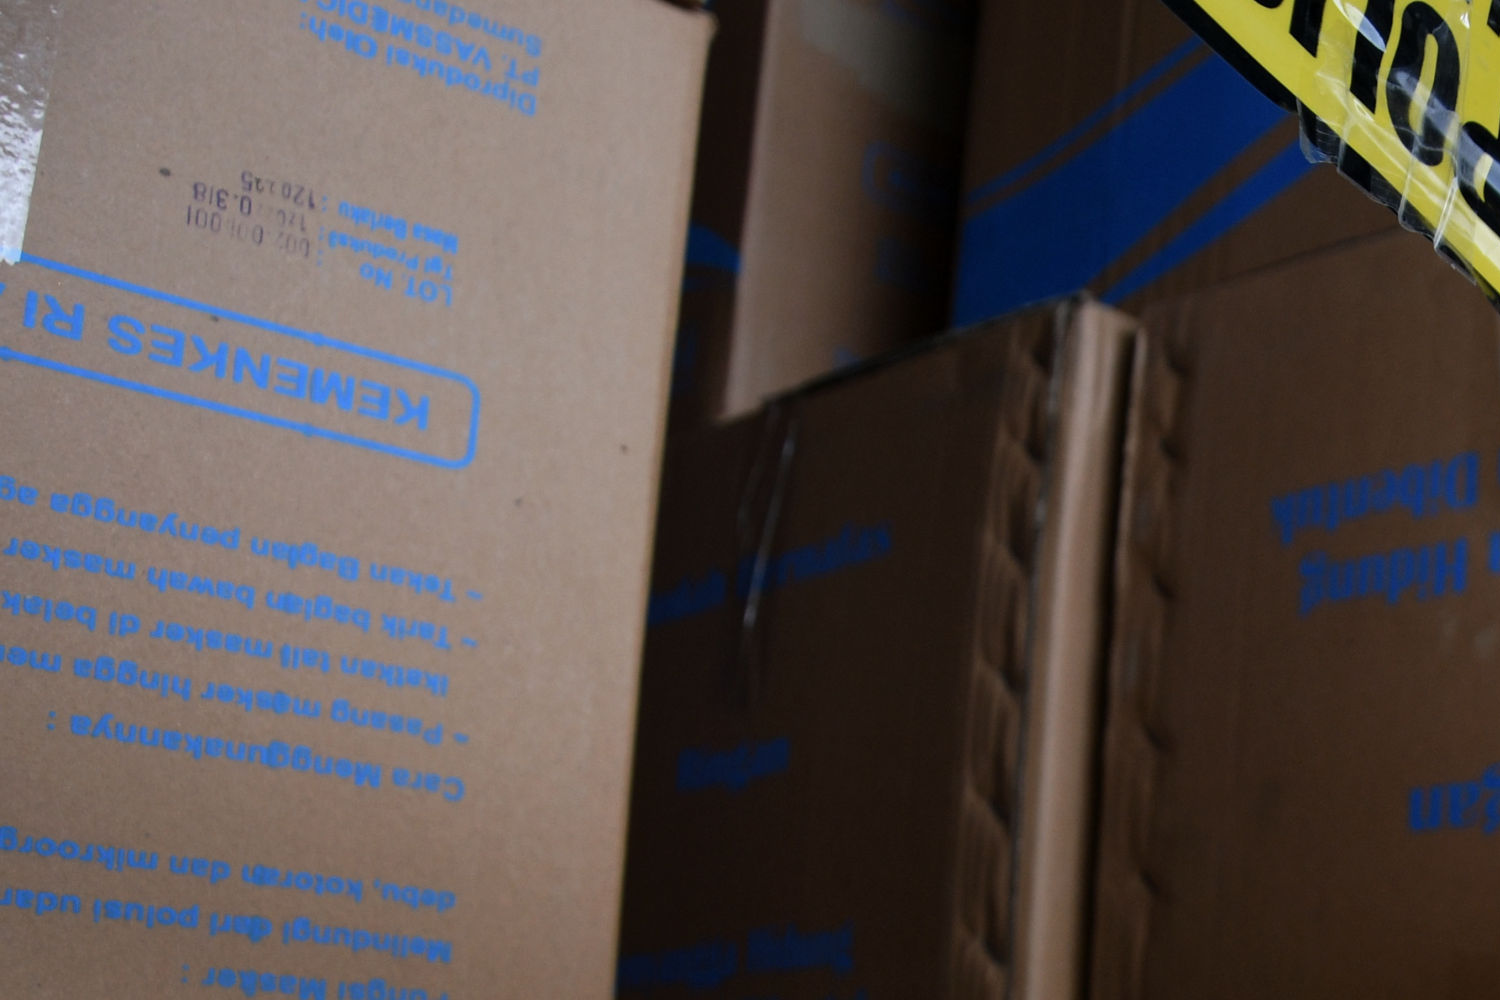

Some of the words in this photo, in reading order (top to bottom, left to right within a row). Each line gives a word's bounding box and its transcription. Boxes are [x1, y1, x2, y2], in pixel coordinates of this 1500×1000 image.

[300, 0, 493, 72] VASSMEDIC
[402, 0, 542, 58] Sumedan
[385, 44, 537, 117] Diproduksi
[359, 262, 394, 291] No
[22, 289, 86, 341] RI
[107, 314, 430, 431] KEMENKES
[50, 491, 241, 550] penyangga
[1269, 451, 1480, 548] Dibentuk
[3, 536, 137, 580] masker
[250, 535, 360, 582] Bagian
[1299, 537, 1470, 619] Hidung
[147, 566, 256, 610] bawah
[370, 561, 456, 602] Tekan
[1, 589, 98, 632] belak
[109, 611, 141, 637] di
[266, 590, 371, 633] bagian
[381, 612, 452, 650] Tarik
[151, 619, 274, 659] masker
[74, 655, 193, 701] hingga
[200, 681, 322, 719] masker
[330, 698, 444, 747] Pasang
[70, 712, 382, 790] Menggunakannya
[391, 766, 467, 803] Cara
[0, 825, 159, 872] mikroorg
[170, 854, 231, 885] dan
[242, 863, 364, 903] kotoran
[372, 878, 457, 914] debu,
[93, 898, 200, 929] polusi
[209, 911, 273, 944] dari
[282, 915, 454, 964] Melindungi
